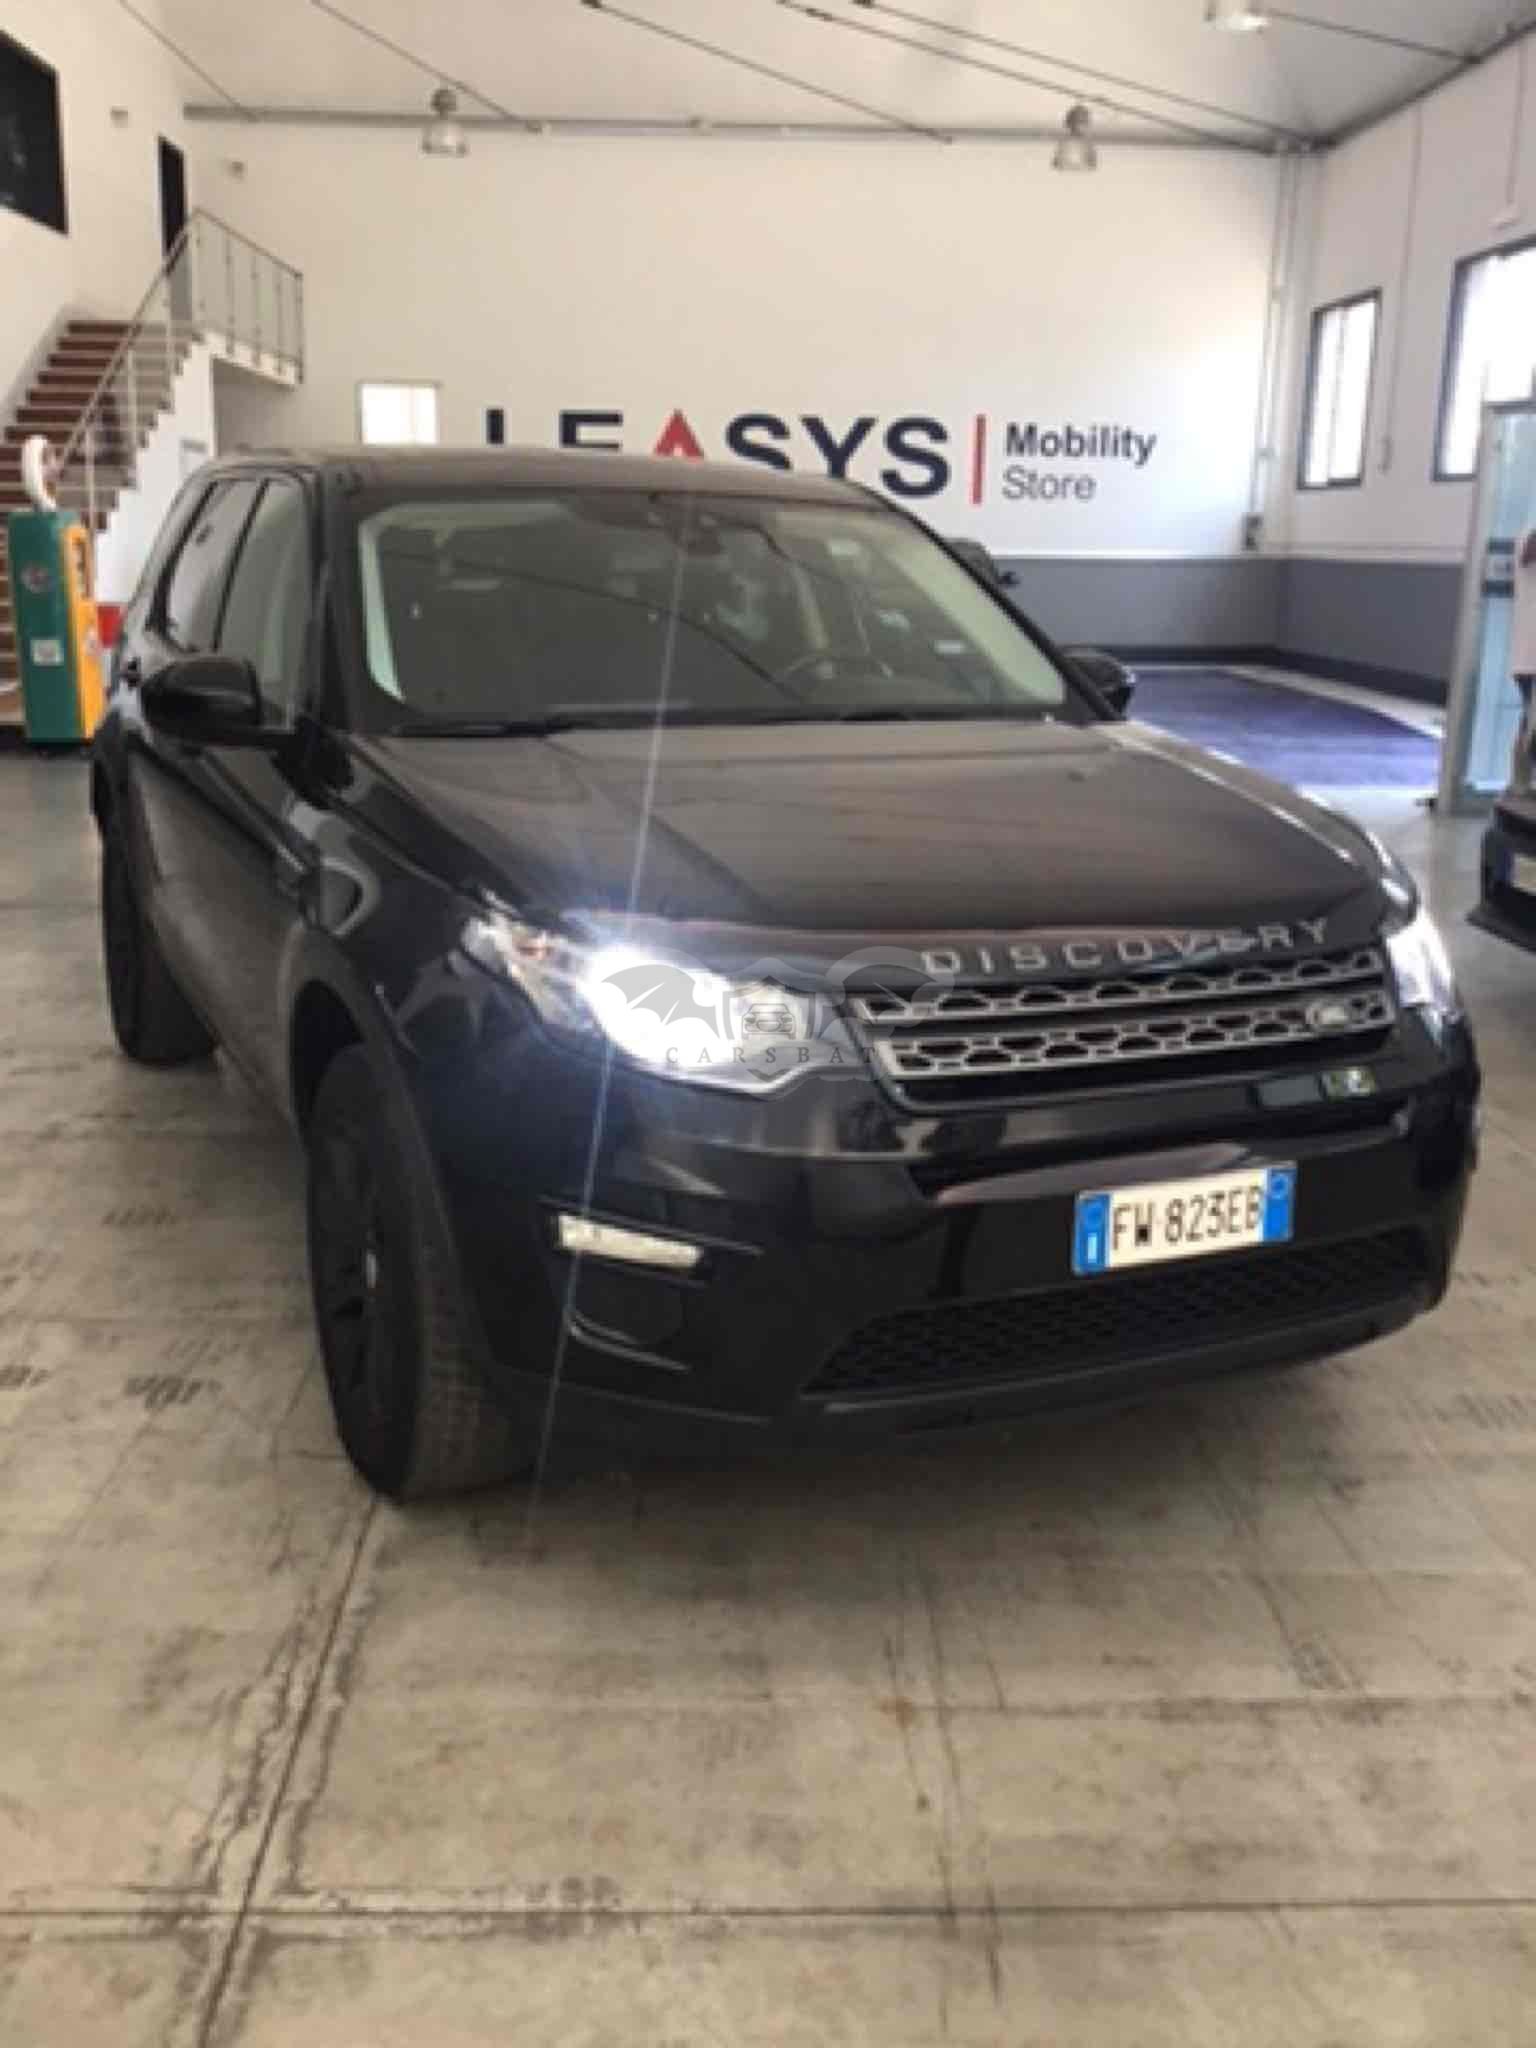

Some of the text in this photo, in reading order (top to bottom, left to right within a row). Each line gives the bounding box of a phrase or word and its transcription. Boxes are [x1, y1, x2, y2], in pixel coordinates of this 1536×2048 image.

[1006, 422, 1157, 466] Mobility
[1002, 464, 1096, 500] Store
[920, 918, 1329, 975] DISCOVERY
[1164, 1184, 1262, 1243] 823EB
